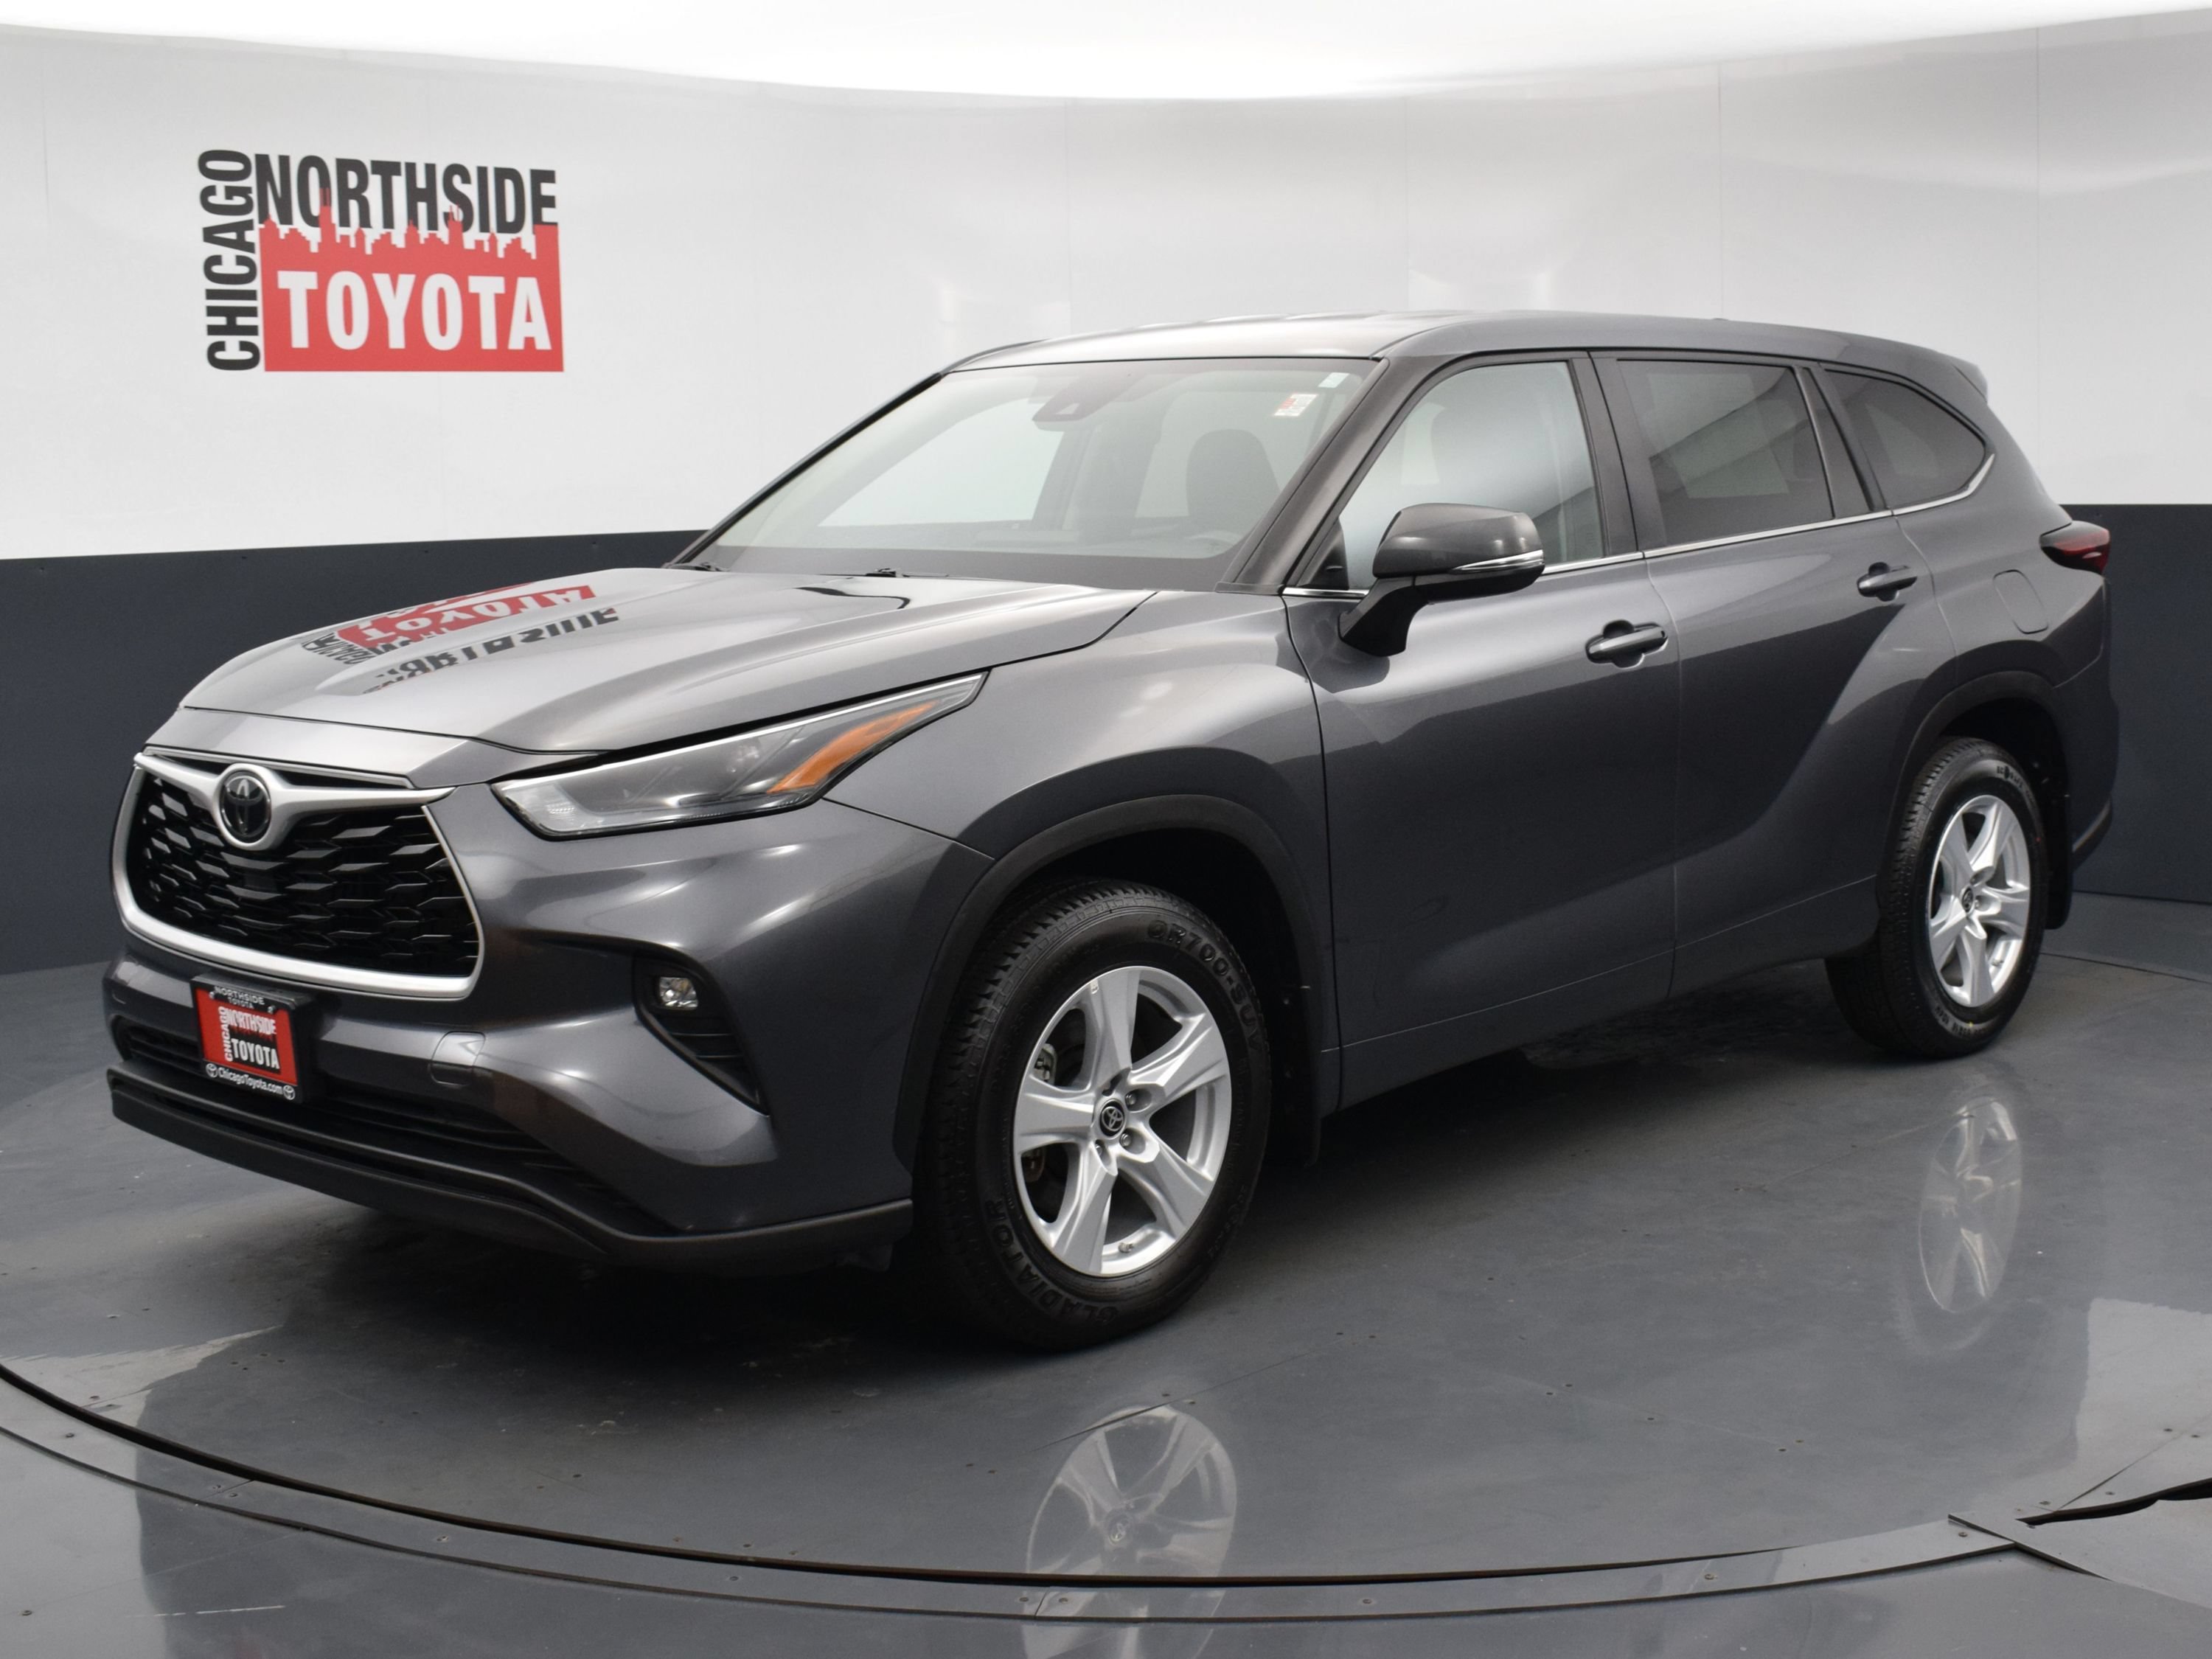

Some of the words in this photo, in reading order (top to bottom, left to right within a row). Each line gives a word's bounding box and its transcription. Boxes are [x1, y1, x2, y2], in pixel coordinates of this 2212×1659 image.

[255, 153, 559, 234] NORTHSIDE
[198, 150, 260, 372] CHICAGO
[277, 271, 552, 350] TOYOTA
[215, 986, 265, 1005] NORTHSIDE
[226, 1008, 276, 1035] NORTHSIDE
[231, 1038, 280, 1069] TOYOTA
[985, 1200, 1119, 1326] GLADIATOR
